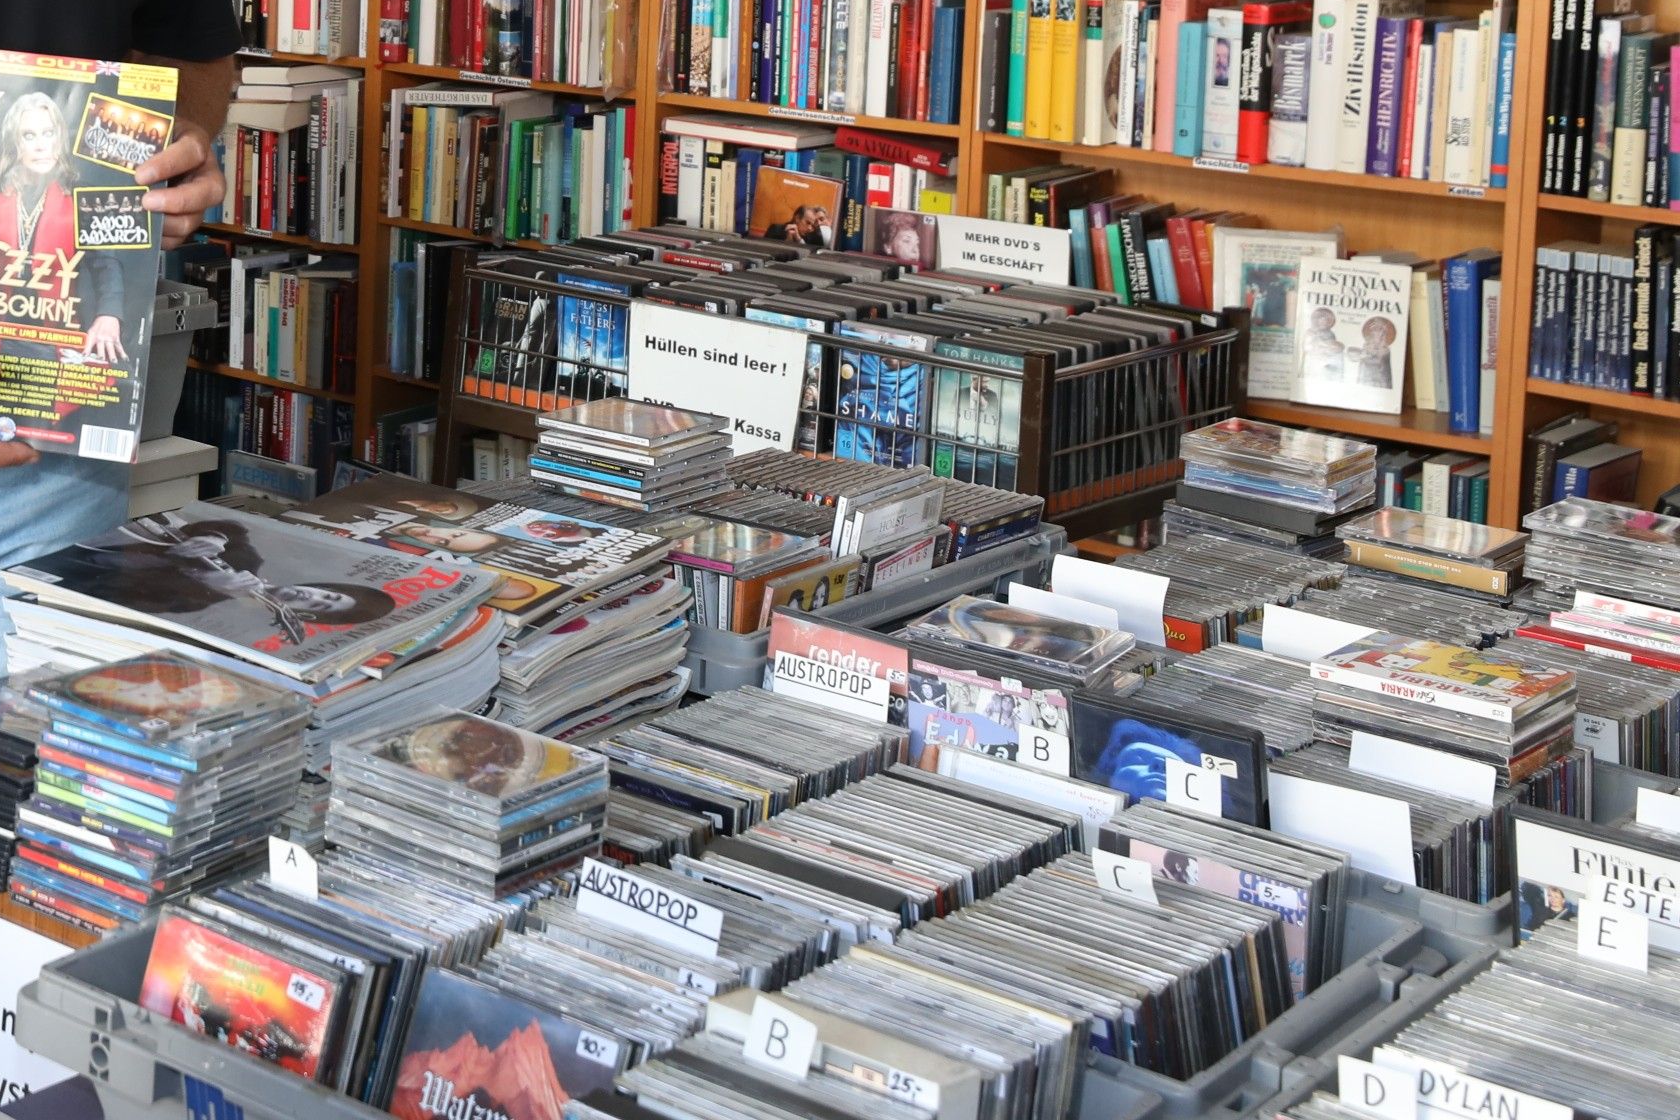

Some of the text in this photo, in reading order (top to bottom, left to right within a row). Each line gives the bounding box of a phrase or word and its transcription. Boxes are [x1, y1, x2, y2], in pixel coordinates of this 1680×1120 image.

[1343, 2, 1369, 116] Zivilisation
[460, 72, 531, 87] Geschichte Österreich
[1275, 40, 1306, 113] Bismarck
[1377, 50, 1395, 128] HEINRICH
[769, 106, 856, 124] Geheimwissenschaften
[309, 111, 319, 152] PANZER
[661, 140, 679, 197] INTERPOL
[1195, 158, 1249, 171] Geschichte
[964, 232, 1000, 246] MEHR
[962, 250, 1044, 273] IM GESCHÄFT
[1310, 270, 1401, 294] JUSTINIAN
[1305, 291, 1403, 316] THEODORA
[19, 328, 38, 337] UND
[643, 334, 699, 361] Hüllen
[703, 346, 739, 368] sind
[743, 355, 777, 375] leer
[840, 397, 915, 428] SHAME
[733, 417, 782, 442] Kassa
[776, 654, 873, 698] AUSTROPOP
[1034, 735, 1049, 762] B
[1185, 772, 1200, 801] C
[286, 846, 298, 868] A
[1113, 864, 1132, 893] C
[582, 864, 699, 928] AUSTROPOP
[1597, 916, 1617, 949] E
[765, 1018, 788, 1060] B
[1362, 1072, 1386, 1108] D
[1417, 1069, 1518, 1120] DYLAN
